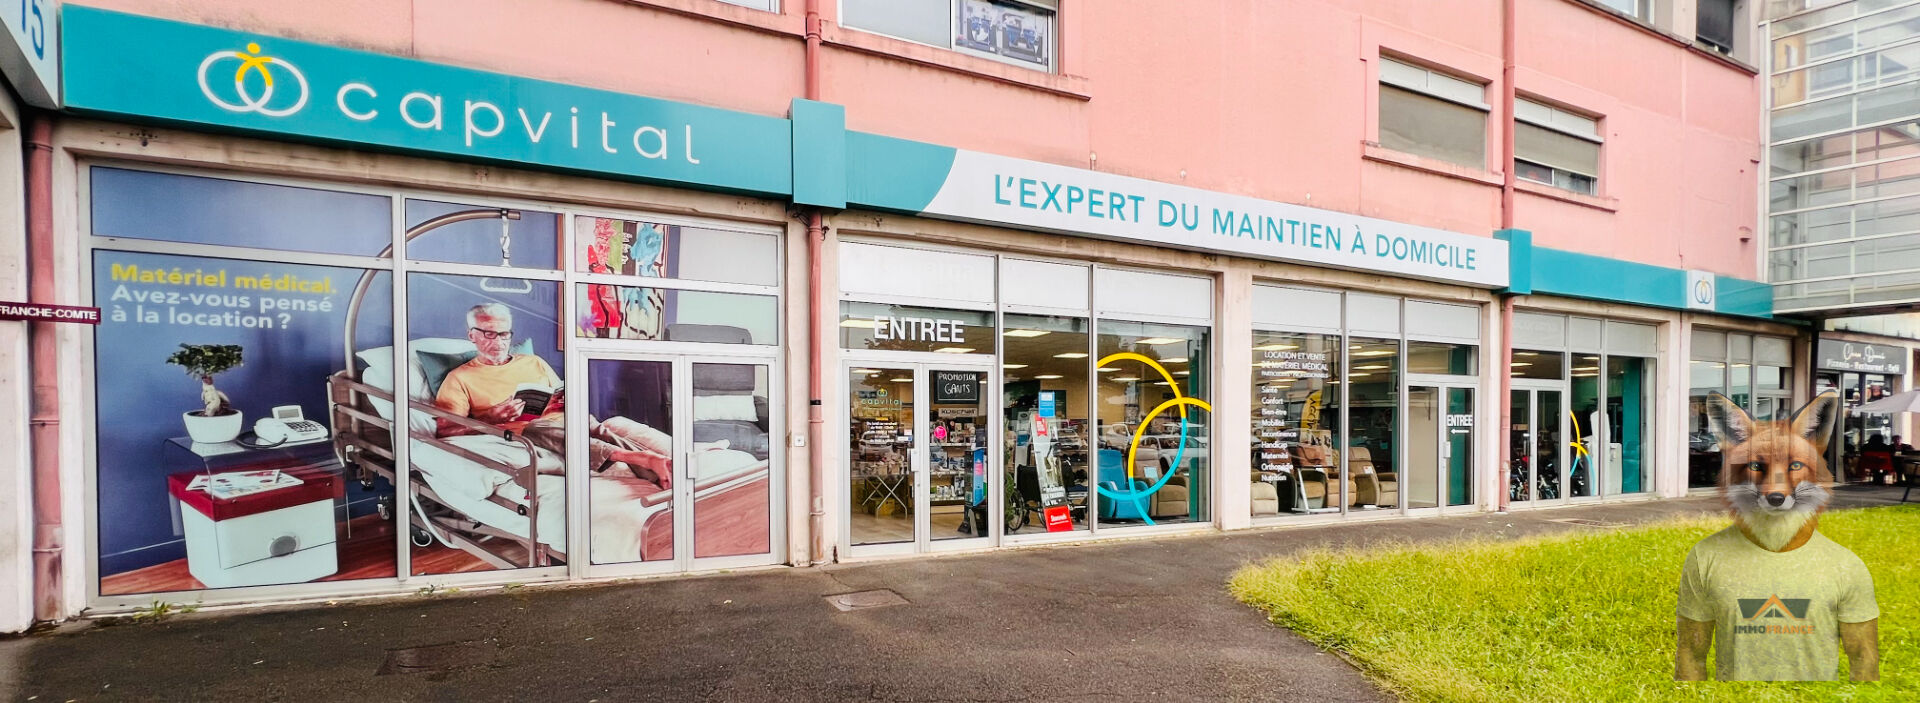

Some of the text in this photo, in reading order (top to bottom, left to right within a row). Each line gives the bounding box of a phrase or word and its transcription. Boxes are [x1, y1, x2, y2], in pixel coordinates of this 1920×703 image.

[337, 83, 700, 165] capvital
[994, 174, 1476, 270] L'EXPERT DU MAINTIEN À DOMICILE
[111, 263, 337, 294] Matériel médical.
[111, 284, 333, 313] Avez-vous pensé
[0, 305, 97, 320] RANCHE-COMTE
[111, 301, 127, 323] à
[136, 305, 159, 324] la
[874, 315, 965, 343] ENTREE
[1264, 351, 1297, 359] LOCATION
[938, 372, 977, 381] PROMOTION
[1261, 396, 1283, 404] Confort
[1447, 414, 1473, 426] ENTREE
[1261, 441, 1288, 450] Handicap
